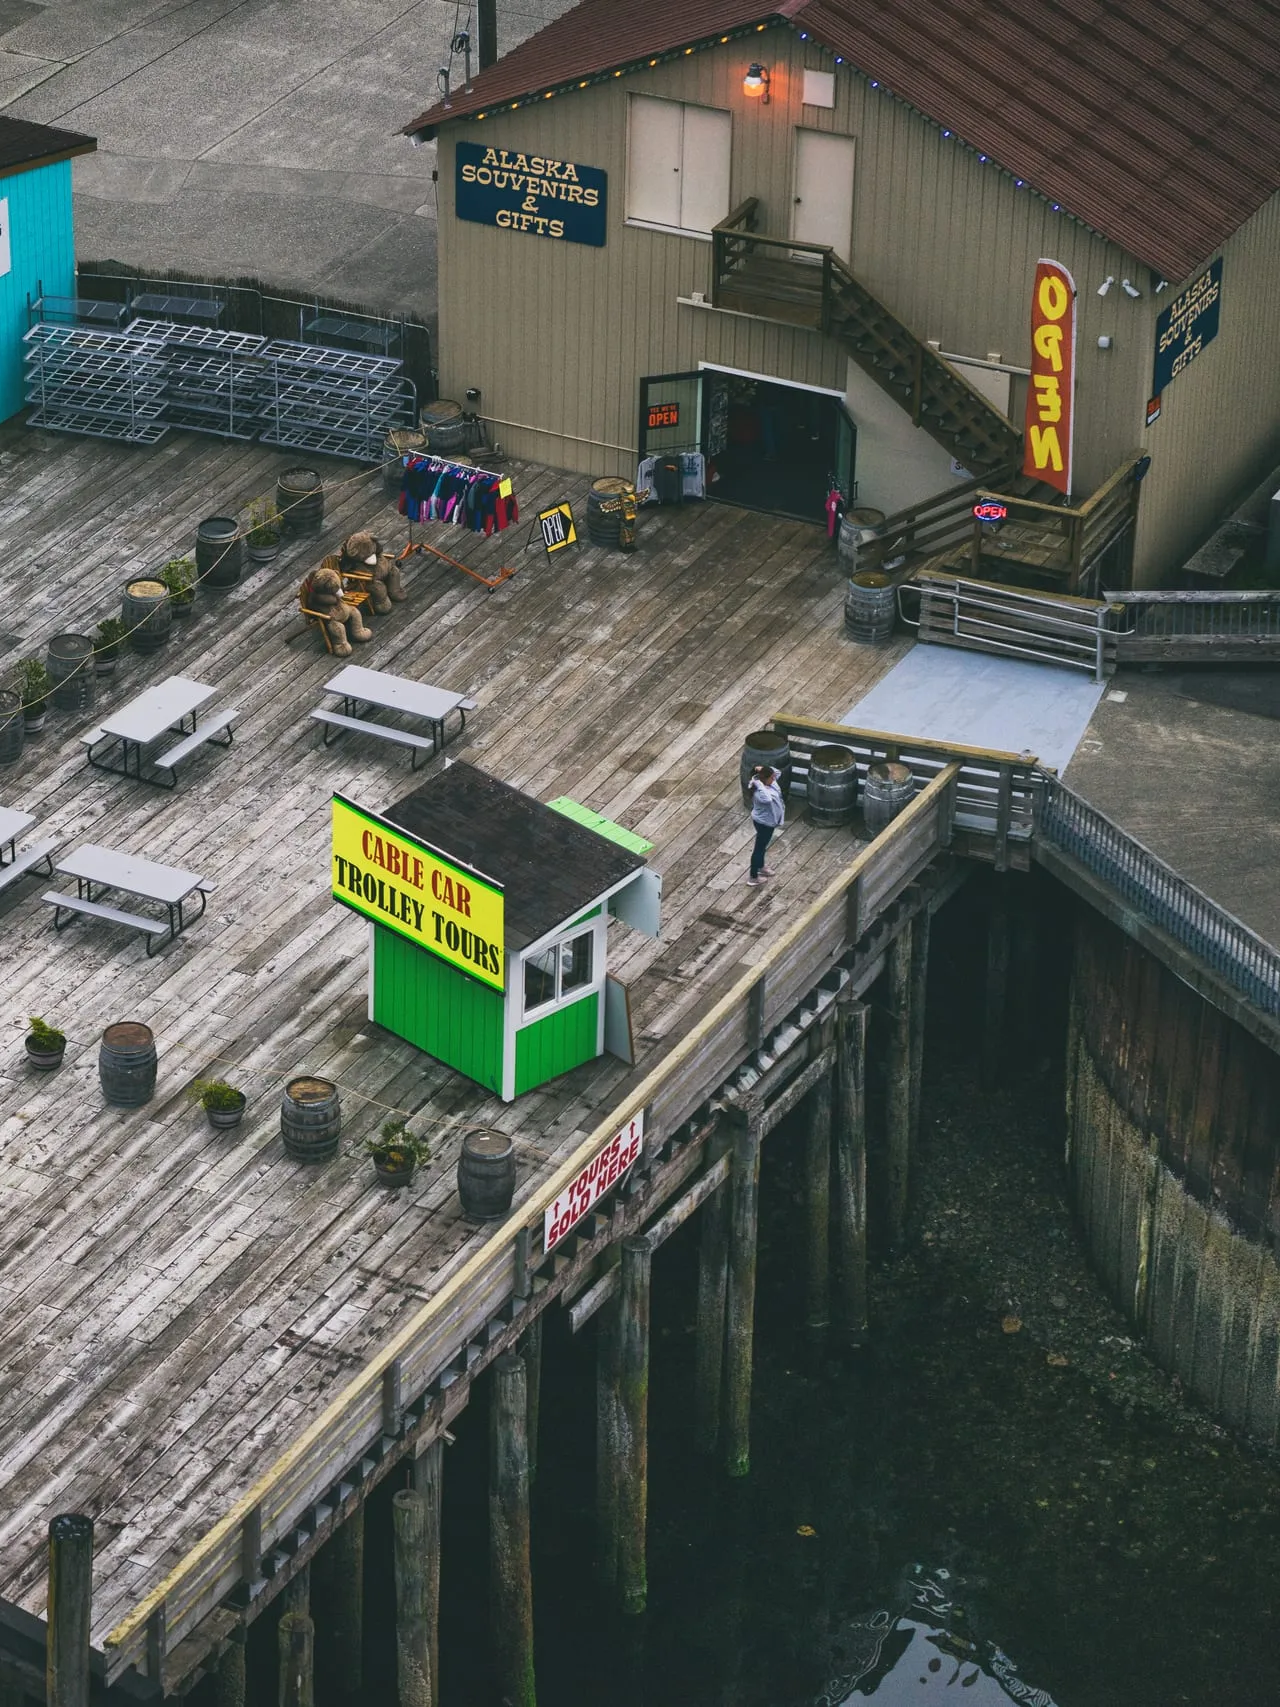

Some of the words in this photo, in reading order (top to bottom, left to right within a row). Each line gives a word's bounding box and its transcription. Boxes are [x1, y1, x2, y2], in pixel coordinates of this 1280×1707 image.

[462, 164, 599, 207] SOUVENIRS
[482, 148, 579, 182] ALASKA
[495, 209, 565, 238] GIFTS
[521, 195, 539, 214] &
[1159, 280, 1219, 353] SOUVENIRS
[1169, 269, 1212, 323] ALASKA
[1171, 333, 1202, 378] GIFTS
[648, 411, 677, 427] OPEN
[542, 512, 565, 547] OPEN
[973, 505, 1007, 518] OPEN
[362, 829, 424, 891] CABLE
[431, 869, 472, 918] CAR
[334, 854, 425, 933] TROLLEY
[431, 911, 500, 976] TOURS
[569, 1134, 622, 1205] TOURS
[547, 1188, 591, 1249] SOLD
[596, 1135, 640, 1198] HERE
